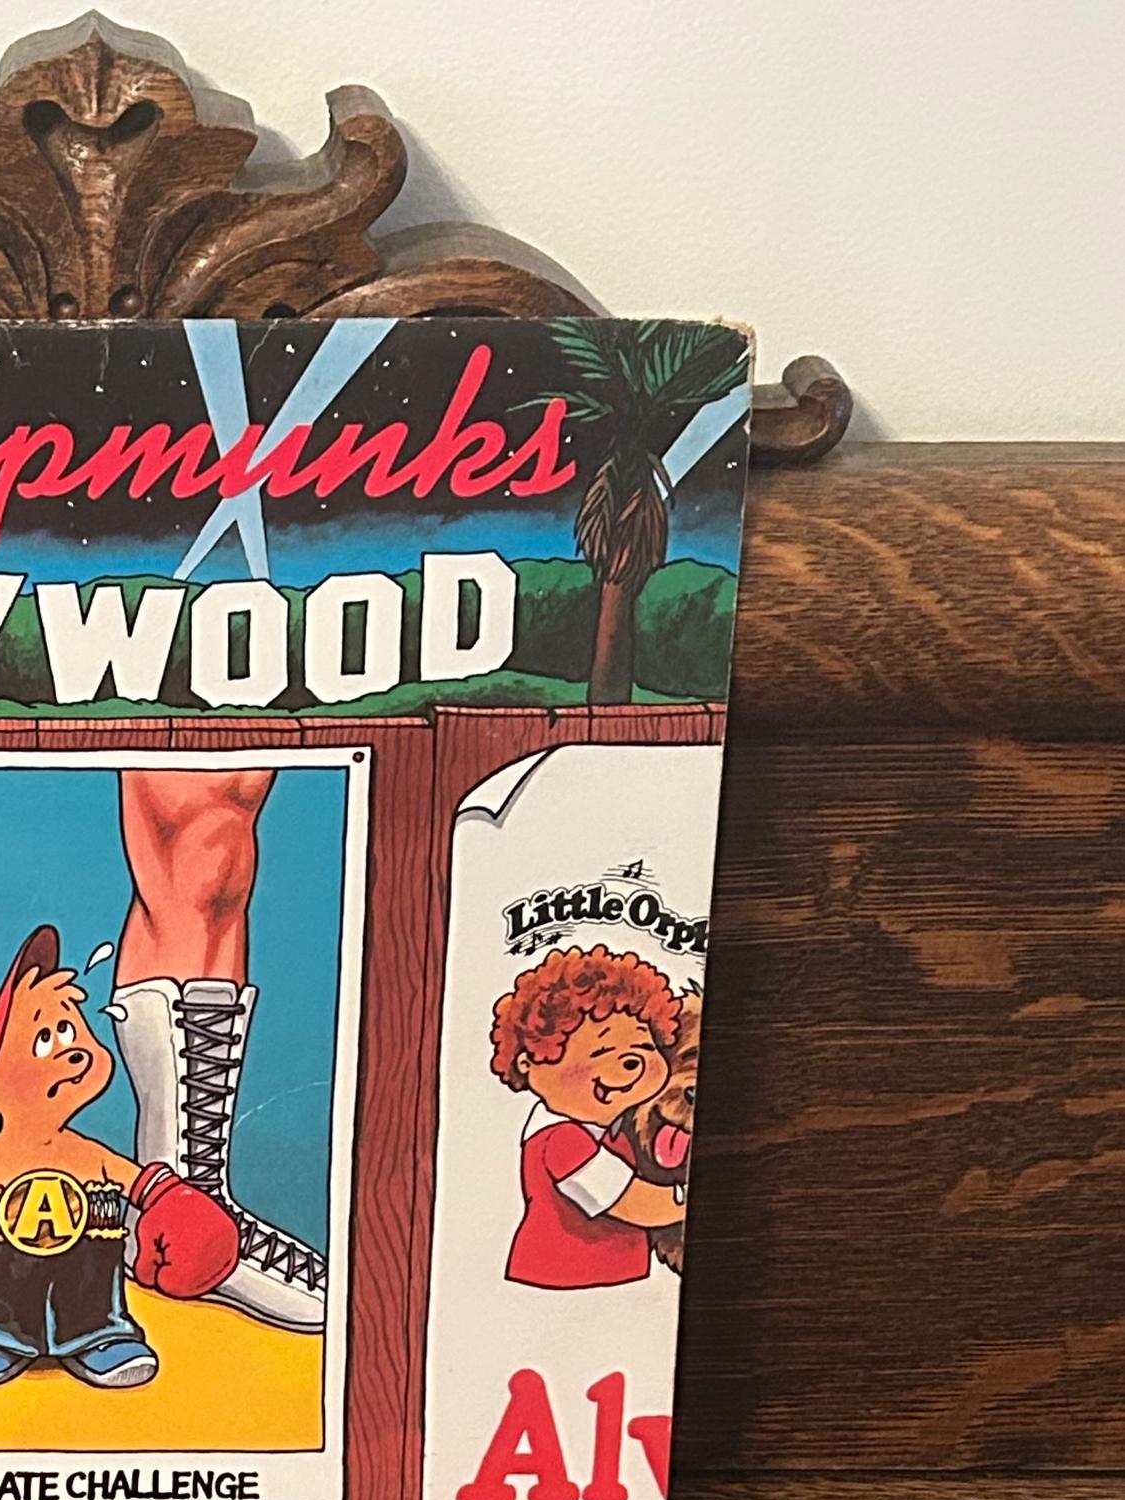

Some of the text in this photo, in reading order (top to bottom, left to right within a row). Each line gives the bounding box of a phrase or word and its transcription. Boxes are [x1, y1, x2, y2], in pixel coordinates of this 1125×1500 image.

[507, 886, 623, 940] Little
[12, 1177, 77, 1240] A
[65, 1469, 260, 1500] CHALLENGE
